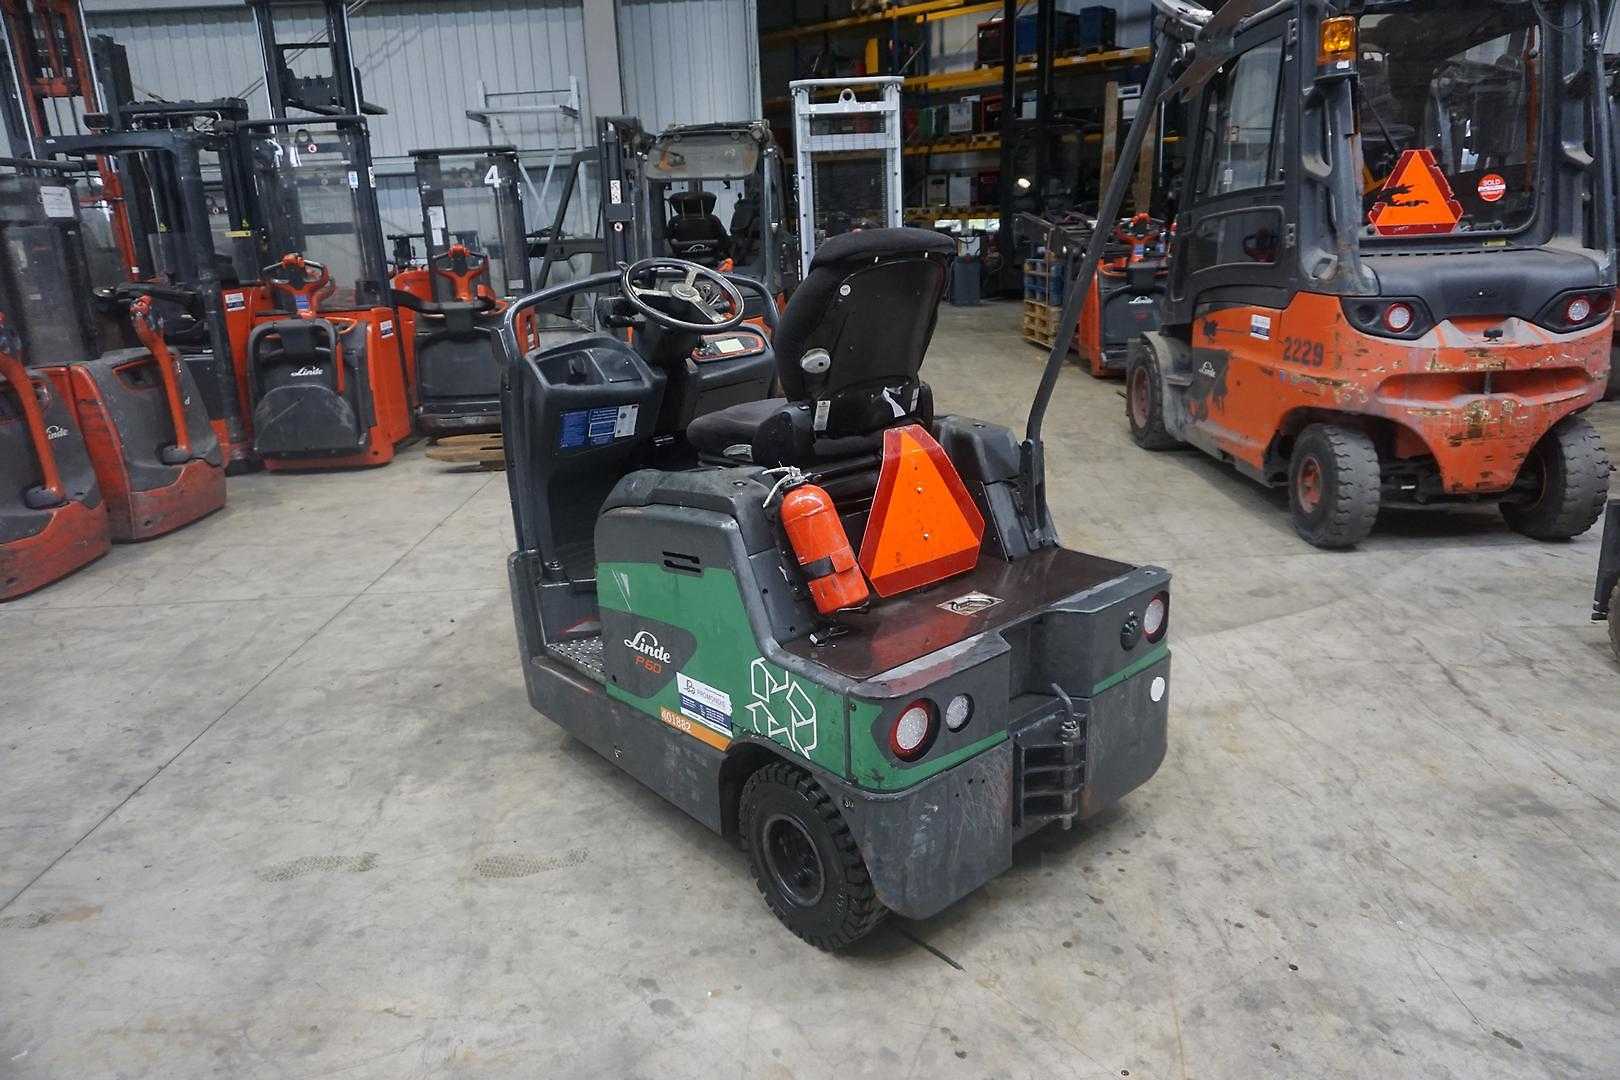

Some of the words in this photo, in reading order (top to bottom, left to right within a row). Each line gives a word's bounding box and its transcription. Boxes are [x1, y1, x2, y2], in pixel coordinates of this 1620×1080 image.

[484, 165, 501, 188] 4
[1283, 336, 1324, 368] 2229
[290, 366, 324, 377] Linde
[624, 630, 672, 664] Linde
